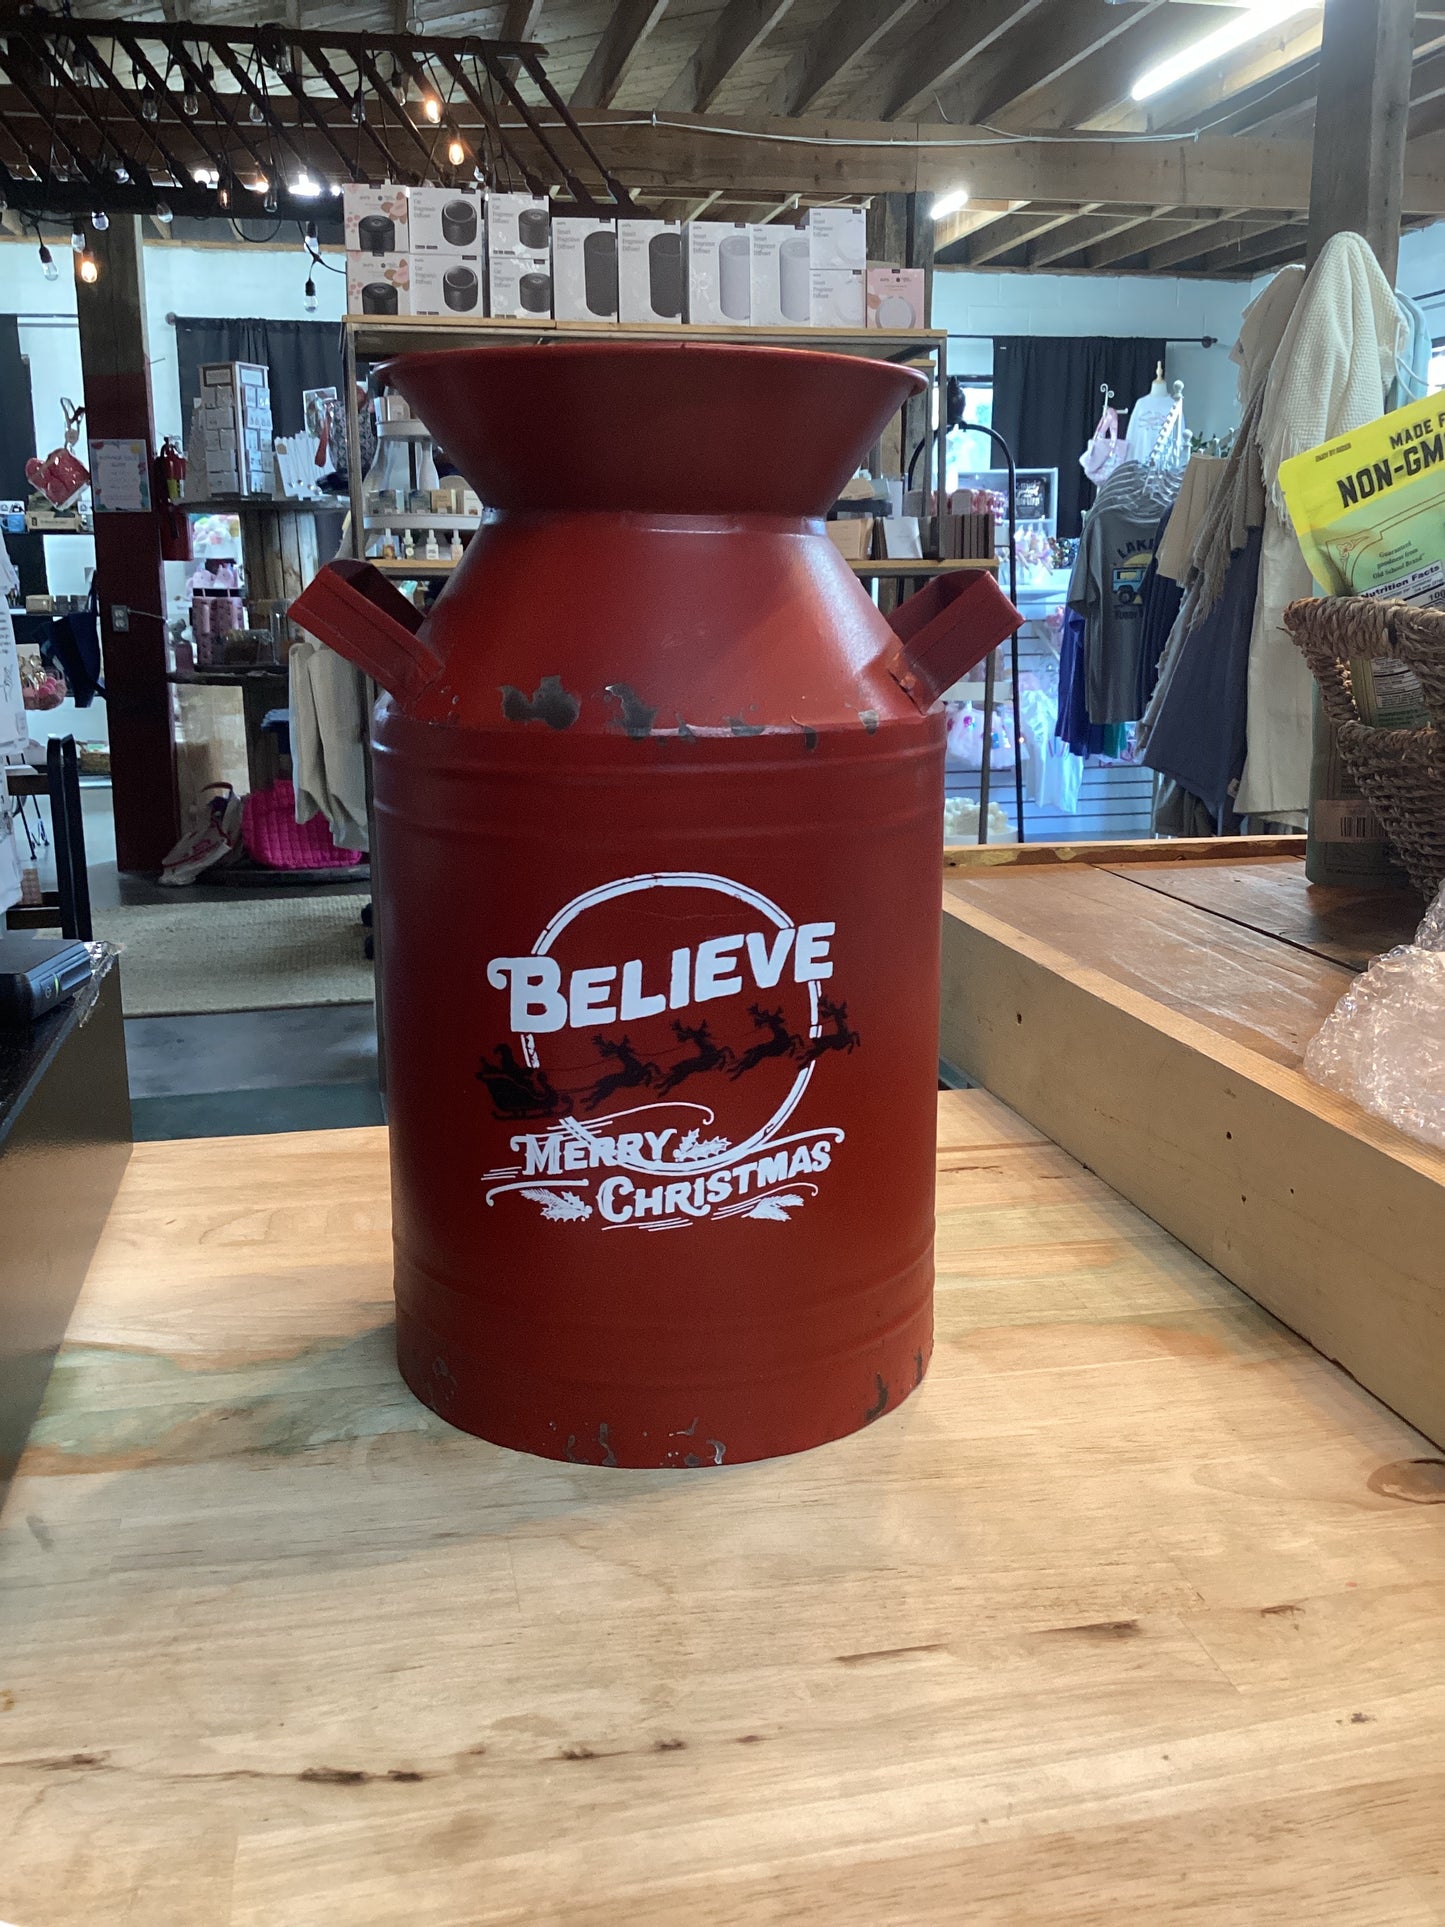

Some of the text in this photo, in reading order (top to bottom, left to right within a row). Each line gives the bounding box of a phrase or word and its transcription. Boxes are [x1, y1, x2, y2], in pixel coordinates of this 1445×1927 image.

[1389, 419, 1434, 450] MADE
[1336, 433, 1445, 509] NON-GM
[1361, 579, 1409, 598] Nutrition
[1411, 564, 1440, 582] Facts
[487, 921, 836, 1033] BELIEVE
[510, 1128, 678, 1176] MERRY
[596, 1140, 832, 1223] CHRISTMAS
